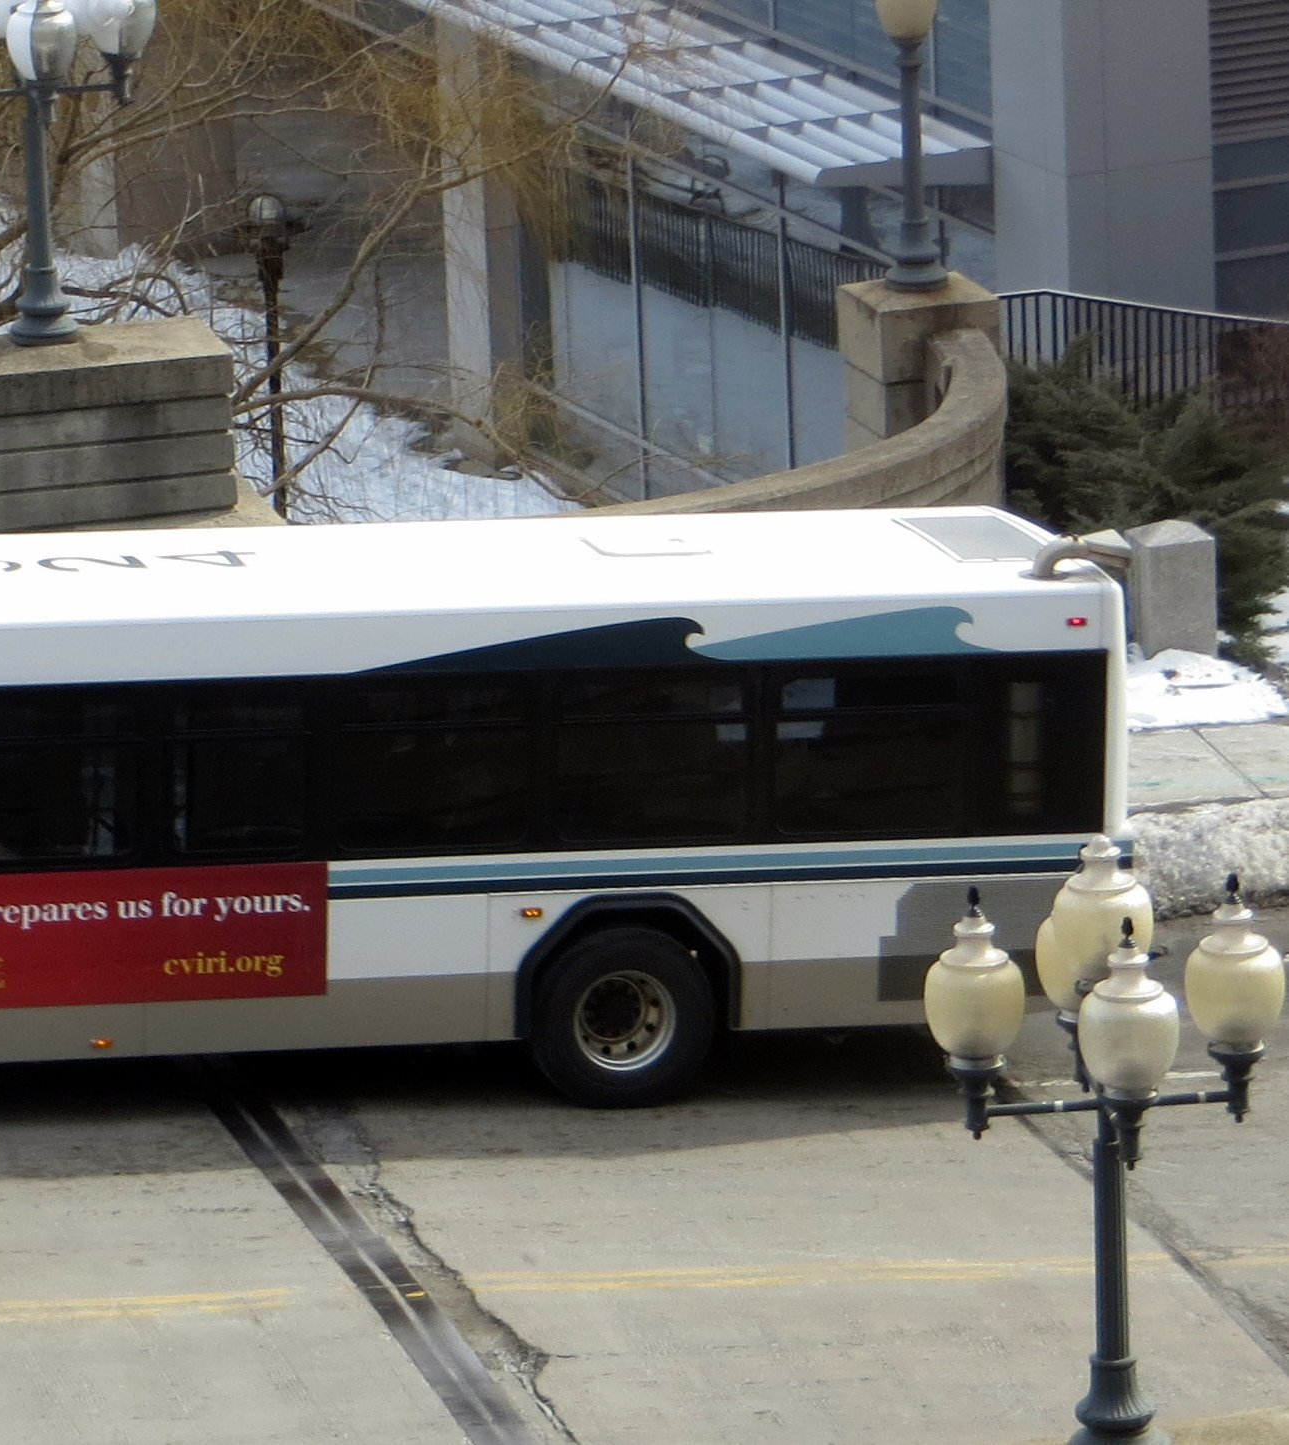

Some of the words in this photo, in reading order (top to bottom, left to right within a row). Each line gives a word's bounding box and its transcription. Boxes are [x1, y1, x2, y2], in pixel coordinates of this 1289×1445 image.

[117, 899, 153, 919] us
[161, 891, 208, 917] for
[213, 892, 311, 921] yours.
[163, 951, 284, 978] cviri.org
